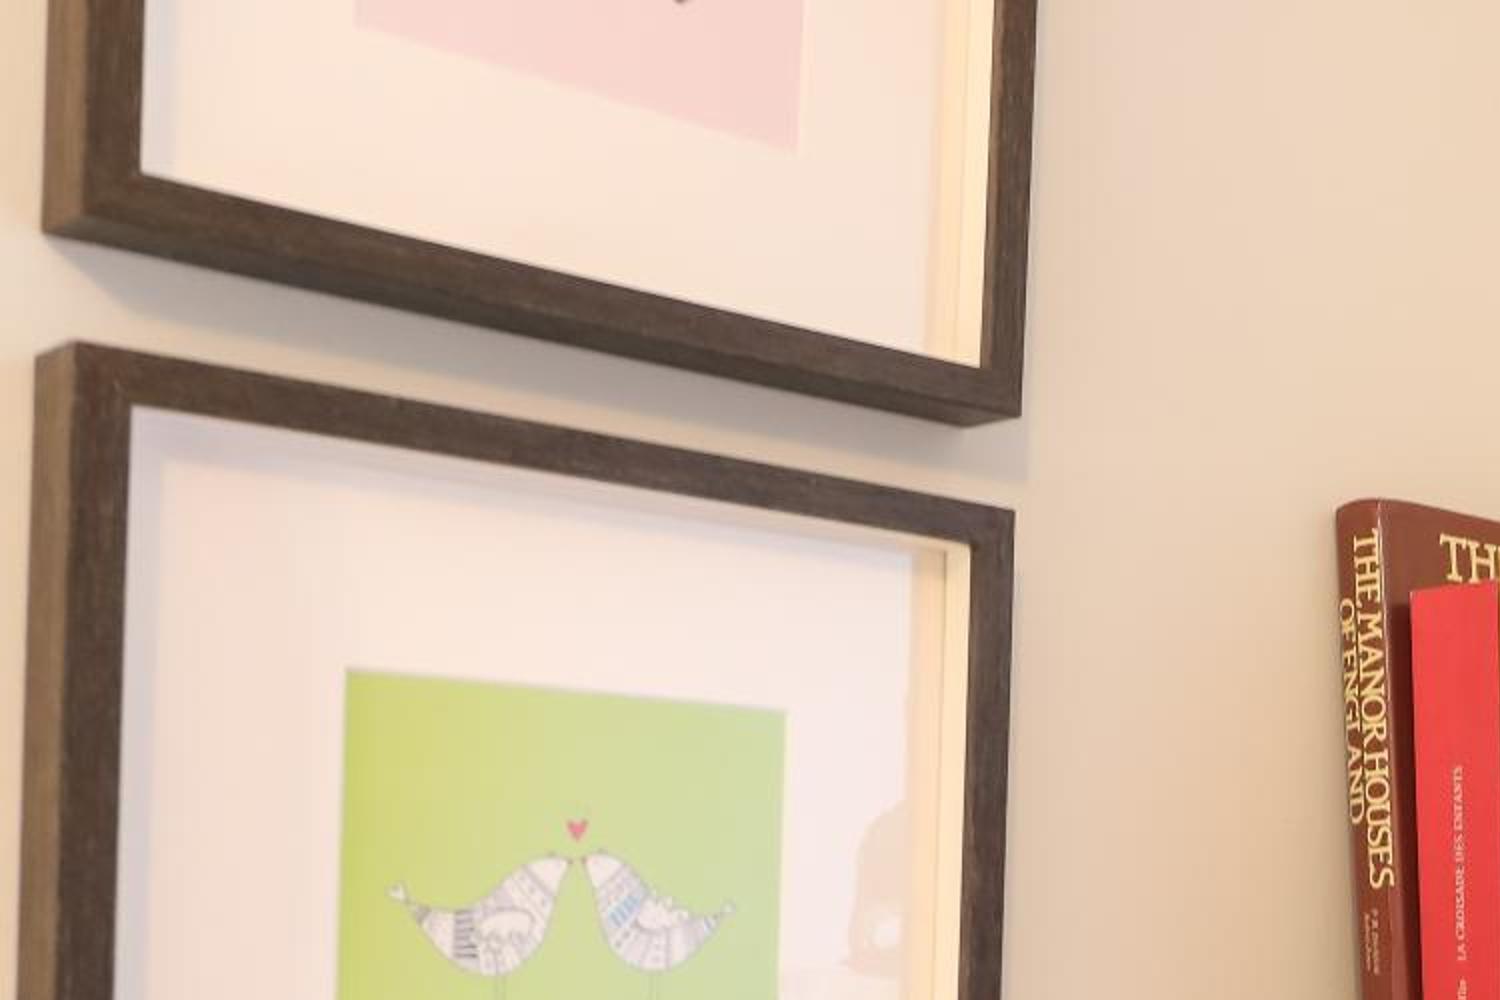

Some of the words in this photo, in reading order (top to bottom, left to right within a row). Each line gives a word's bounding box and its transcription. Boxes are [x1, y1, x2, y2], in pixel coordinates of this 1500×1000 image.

[1339, 598, 1356, 644] OF
[1353, 528, 1383, 606] THE
[1341, 648, 1366, 825] ENGLAND
[1358, 612, 1389, 748] MANOR
[1363, 750, 1394, 888] HOUSES
